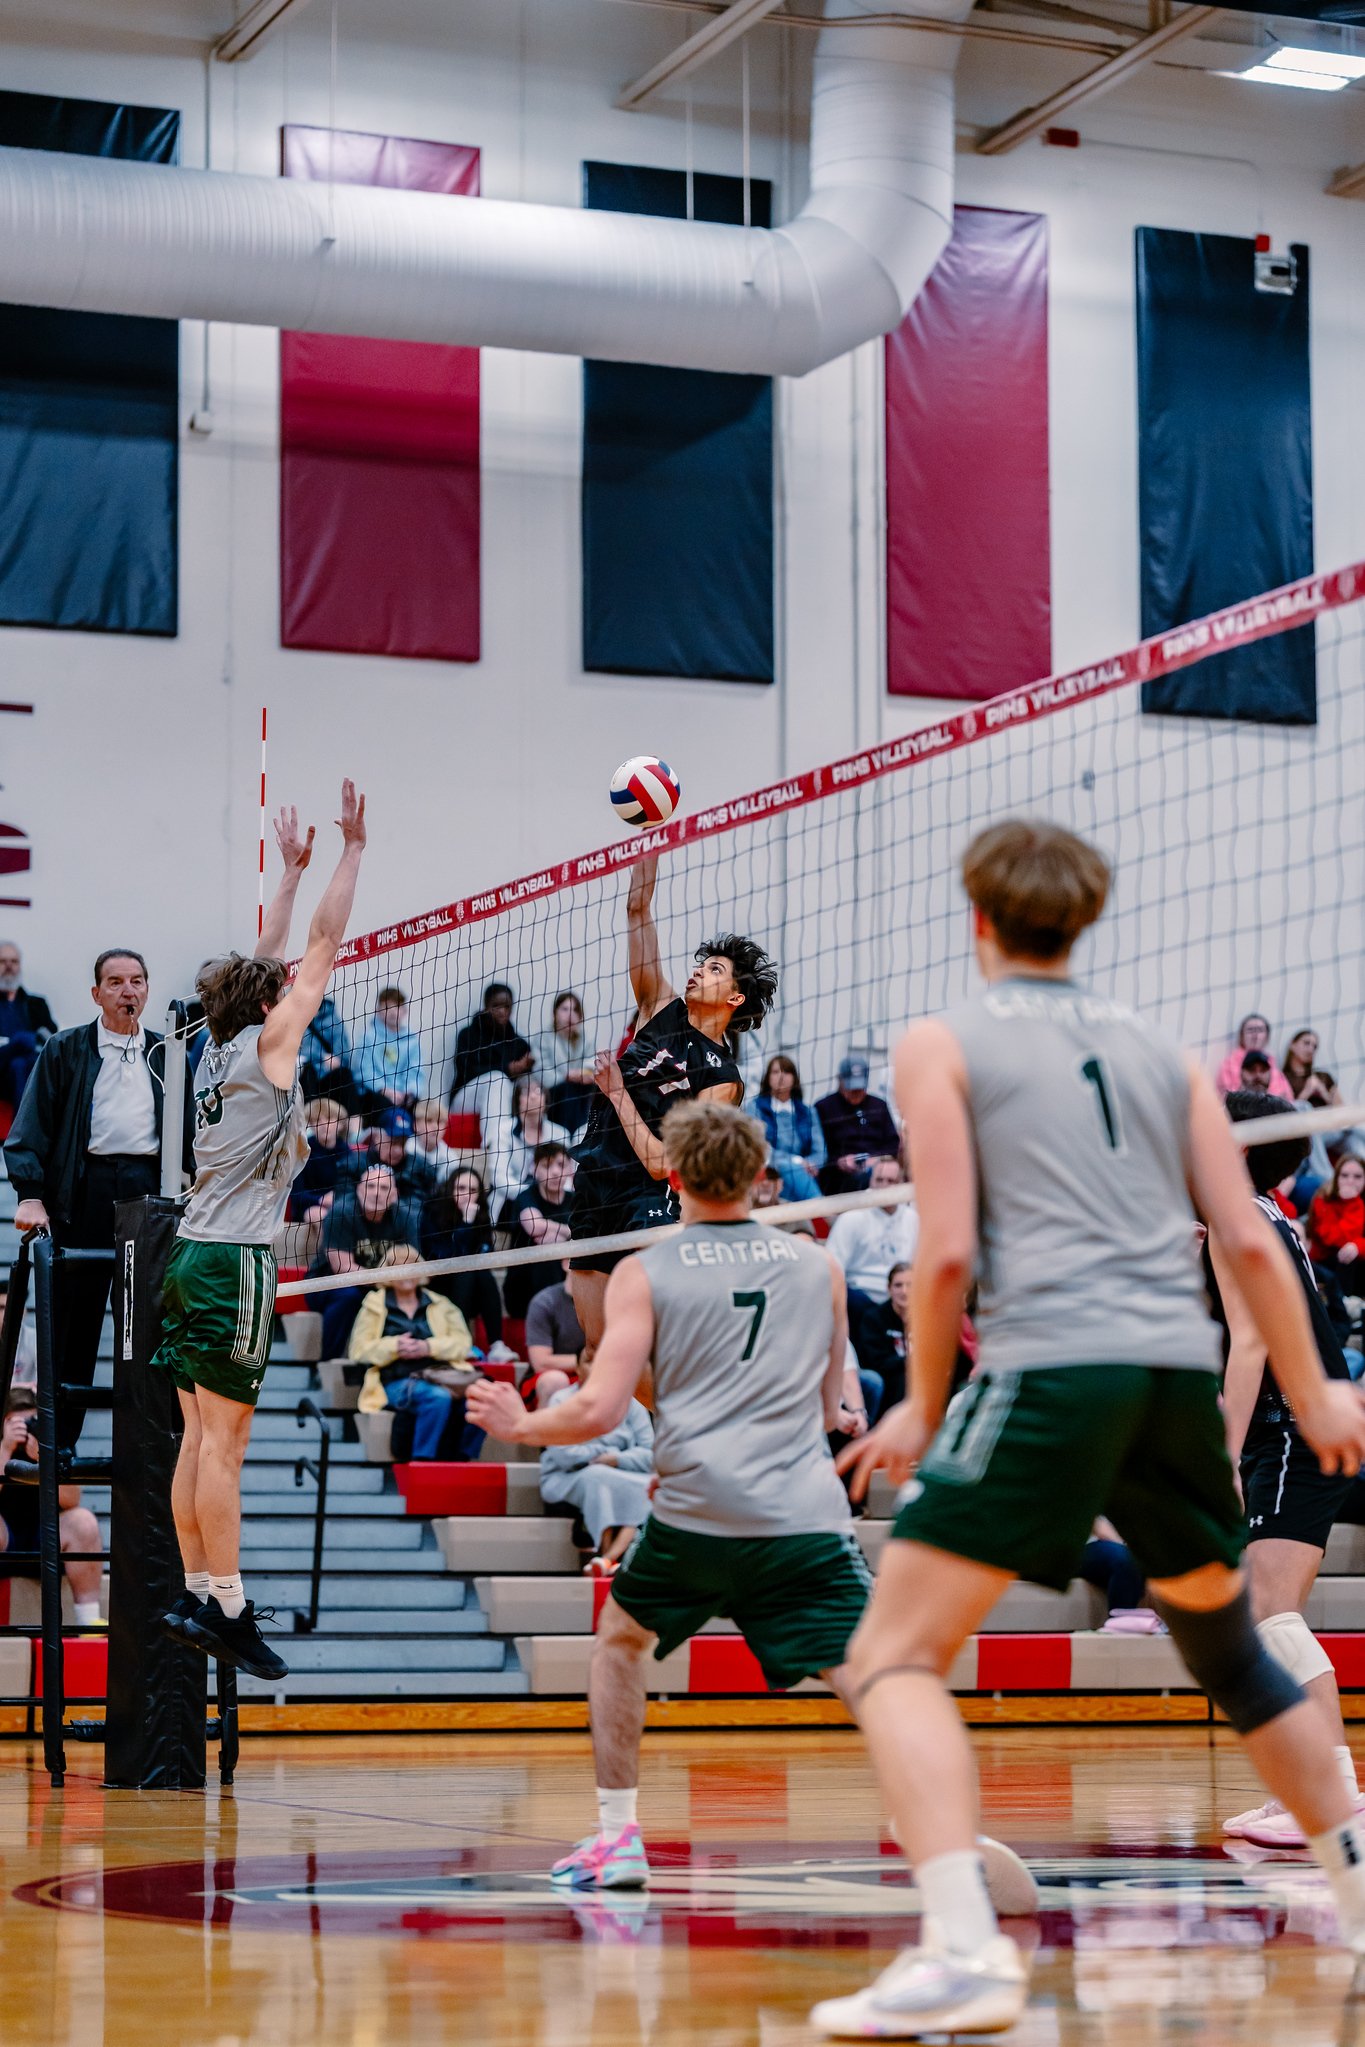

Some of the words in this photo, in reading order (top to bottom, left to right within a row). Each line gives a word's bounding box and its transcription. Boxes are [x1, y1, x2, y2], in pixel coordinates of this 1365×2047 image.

[728, 780, 803, 820] VOLLEYBALL
[577, 853, 605, 876] PNHS
[607, 829, 669, 866] VOLLEYBALL
[471, 894, 496, 915] PNHS
[499, 872, 554, 905] VOLLEYBALL
[377, 928, 398, 948] PNHS
[401, 910, 453, 940] VOLLEYBALL
[1076, 1054, 1123, 1153] 1
[730, 1287, 768, 1365] 7
